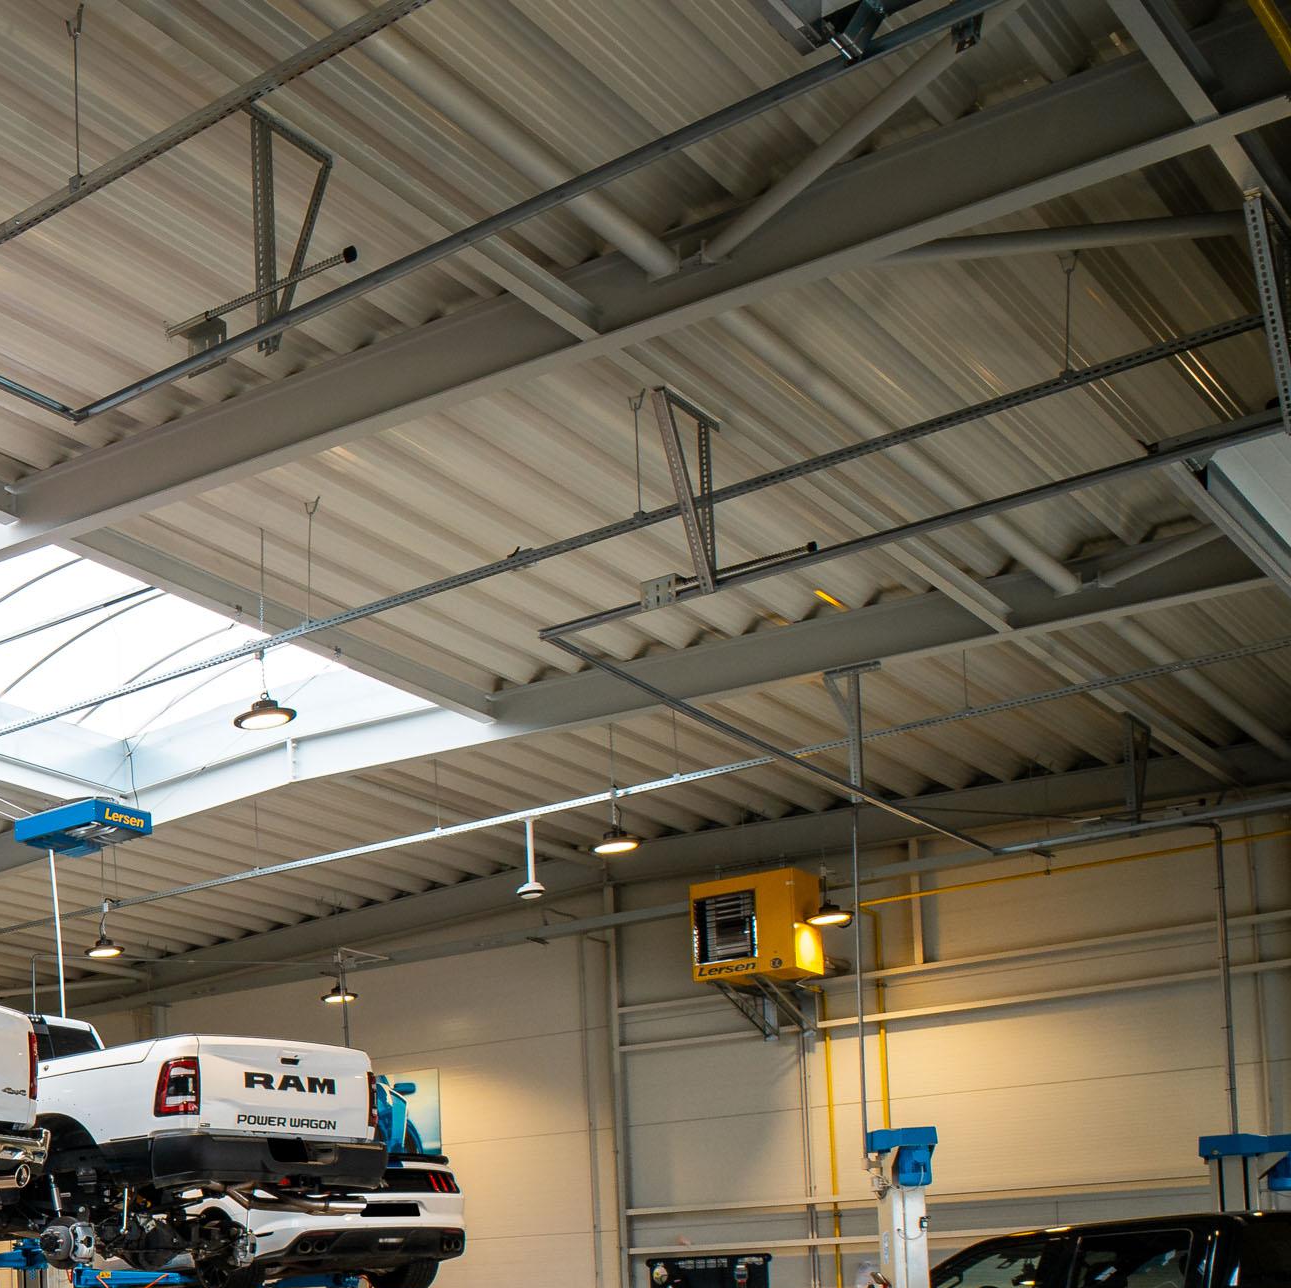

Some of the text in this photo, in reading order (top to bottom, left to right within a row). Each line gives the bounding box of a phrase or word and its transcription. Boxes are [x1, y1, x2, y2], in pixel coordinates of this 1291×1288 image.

[104, 807, 145, 828] Lersen
[698, 962, 756, 977] Lersen
[244, 1071, 336, 1095] RAM
[237, 1114, 337, 1131] POWER WAGON
